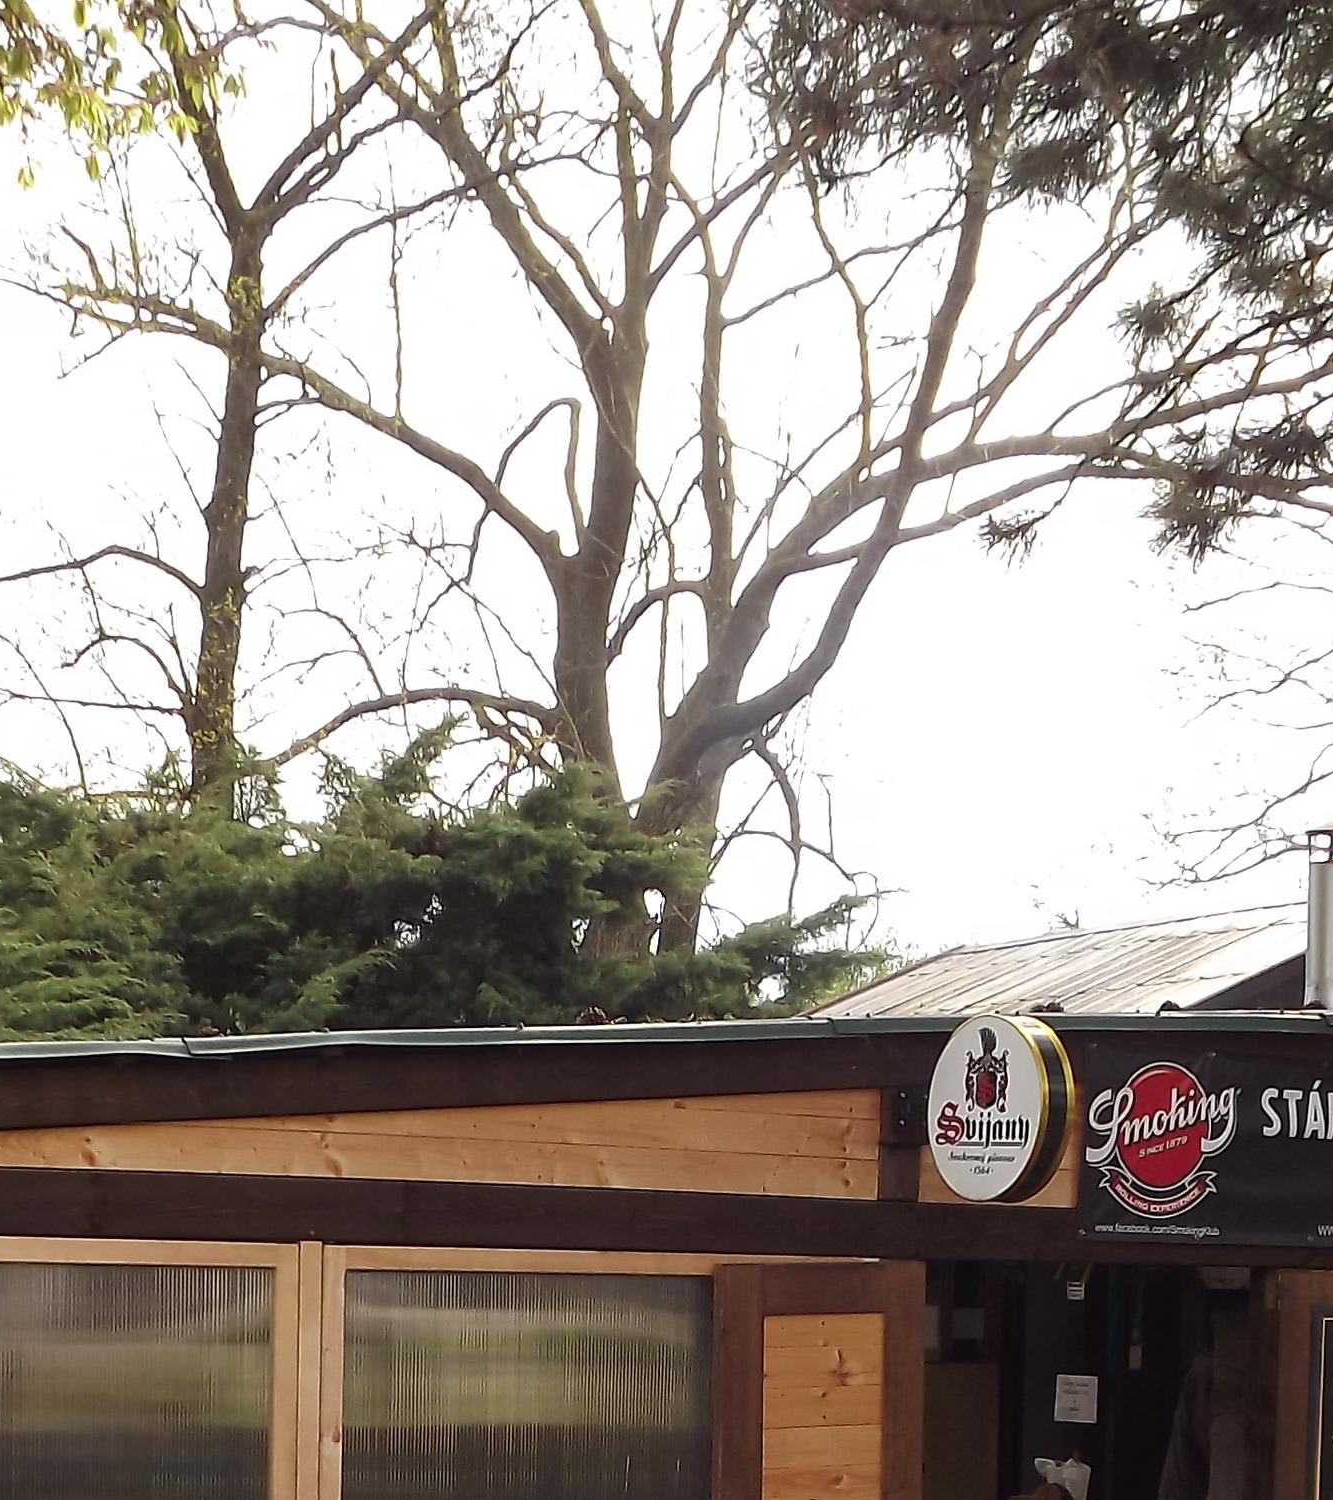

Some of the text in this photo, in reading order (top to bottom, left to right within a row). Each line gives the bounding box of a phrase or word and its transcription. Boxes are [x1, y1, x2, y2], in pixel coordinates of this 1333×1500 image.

[935, 1101, 1030, 1149] Svijany
[1085, 1086, 1238, 1167] Smoking
[1138, 1135, 1188, 1158] SINCE 1879
[1114, 1183, 1150, 1212] ROLLING
